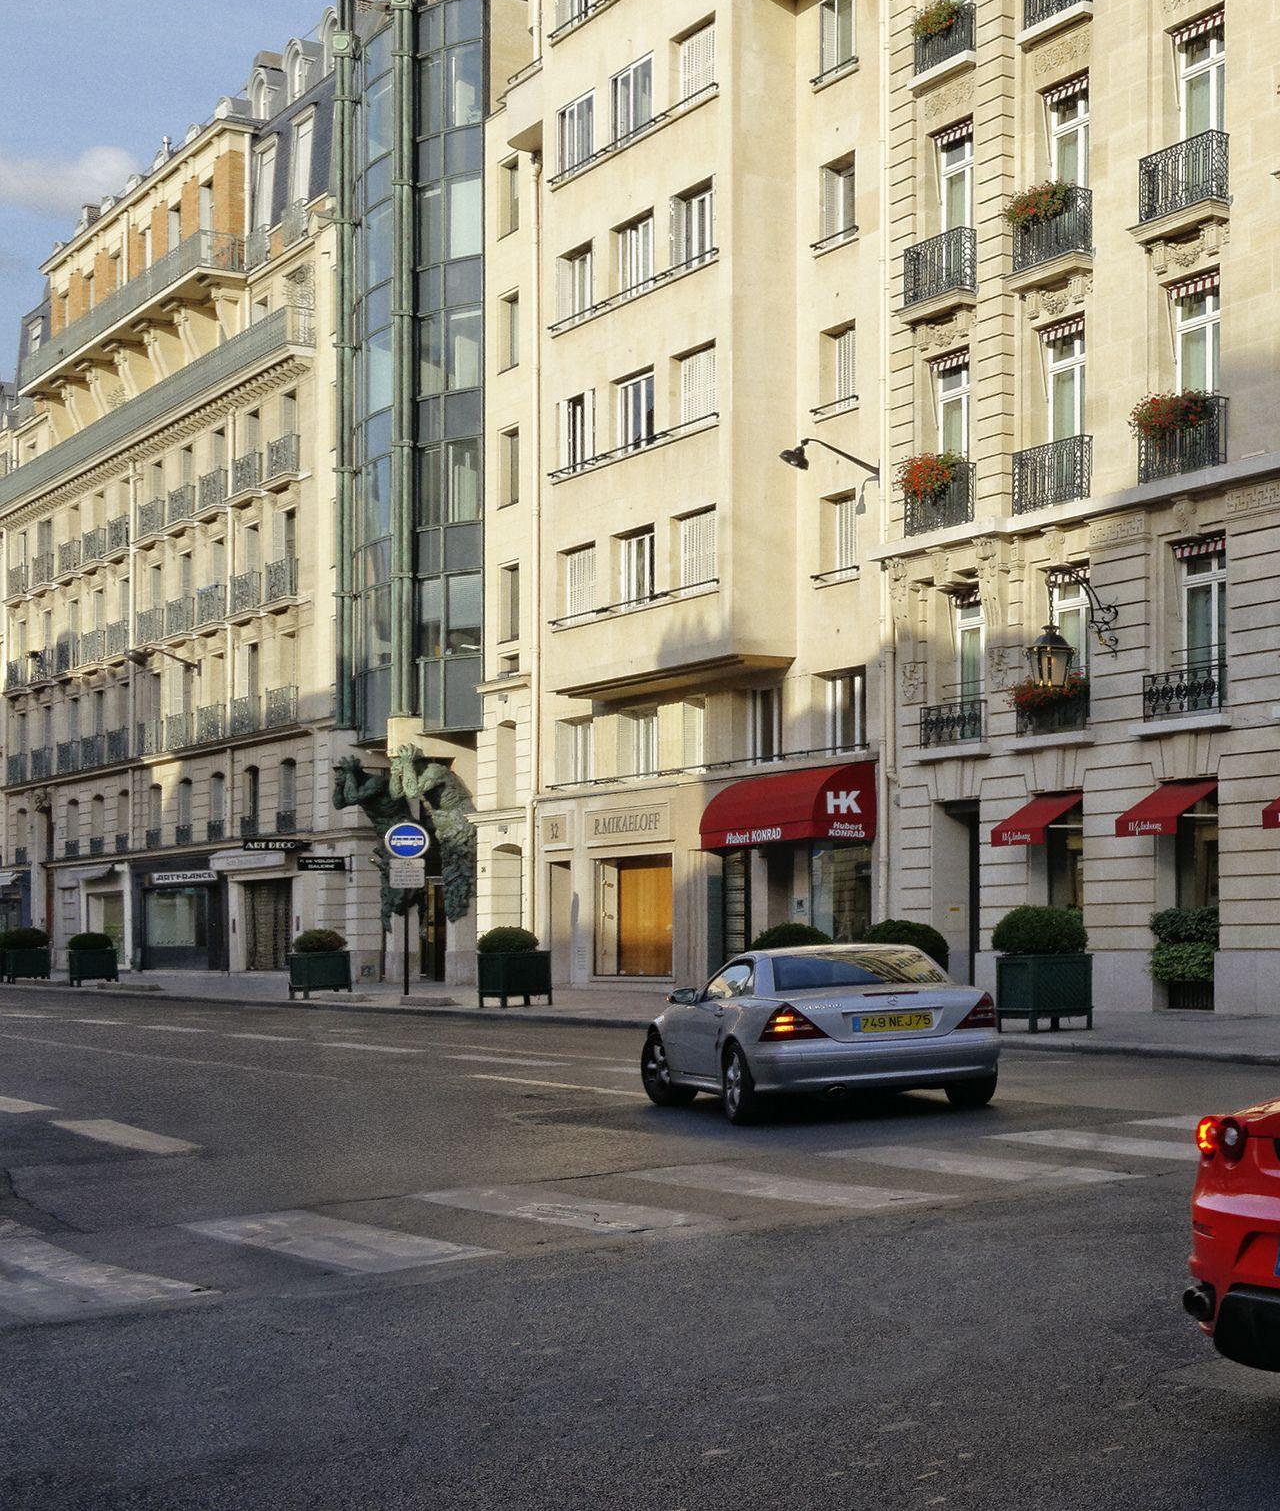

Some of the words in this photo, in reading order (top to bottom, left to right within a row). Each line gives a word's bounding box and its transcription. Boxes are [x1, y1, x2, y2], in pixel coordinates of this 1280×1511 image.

[826, 790, 862, 814] HK
[550, 823, 559, 839] 32
[828, 828, 866, 838] KONRAD
[833, 822, 862, 830] Hubert
[726, 832, 750, 844] Hubert
[751, 828, 782, 842] KONRAD
[862, 1017, 886, 1029] 749
[889, 1015, 913, 1027] NEJ
[915, 1014, 931, 1025] 75
